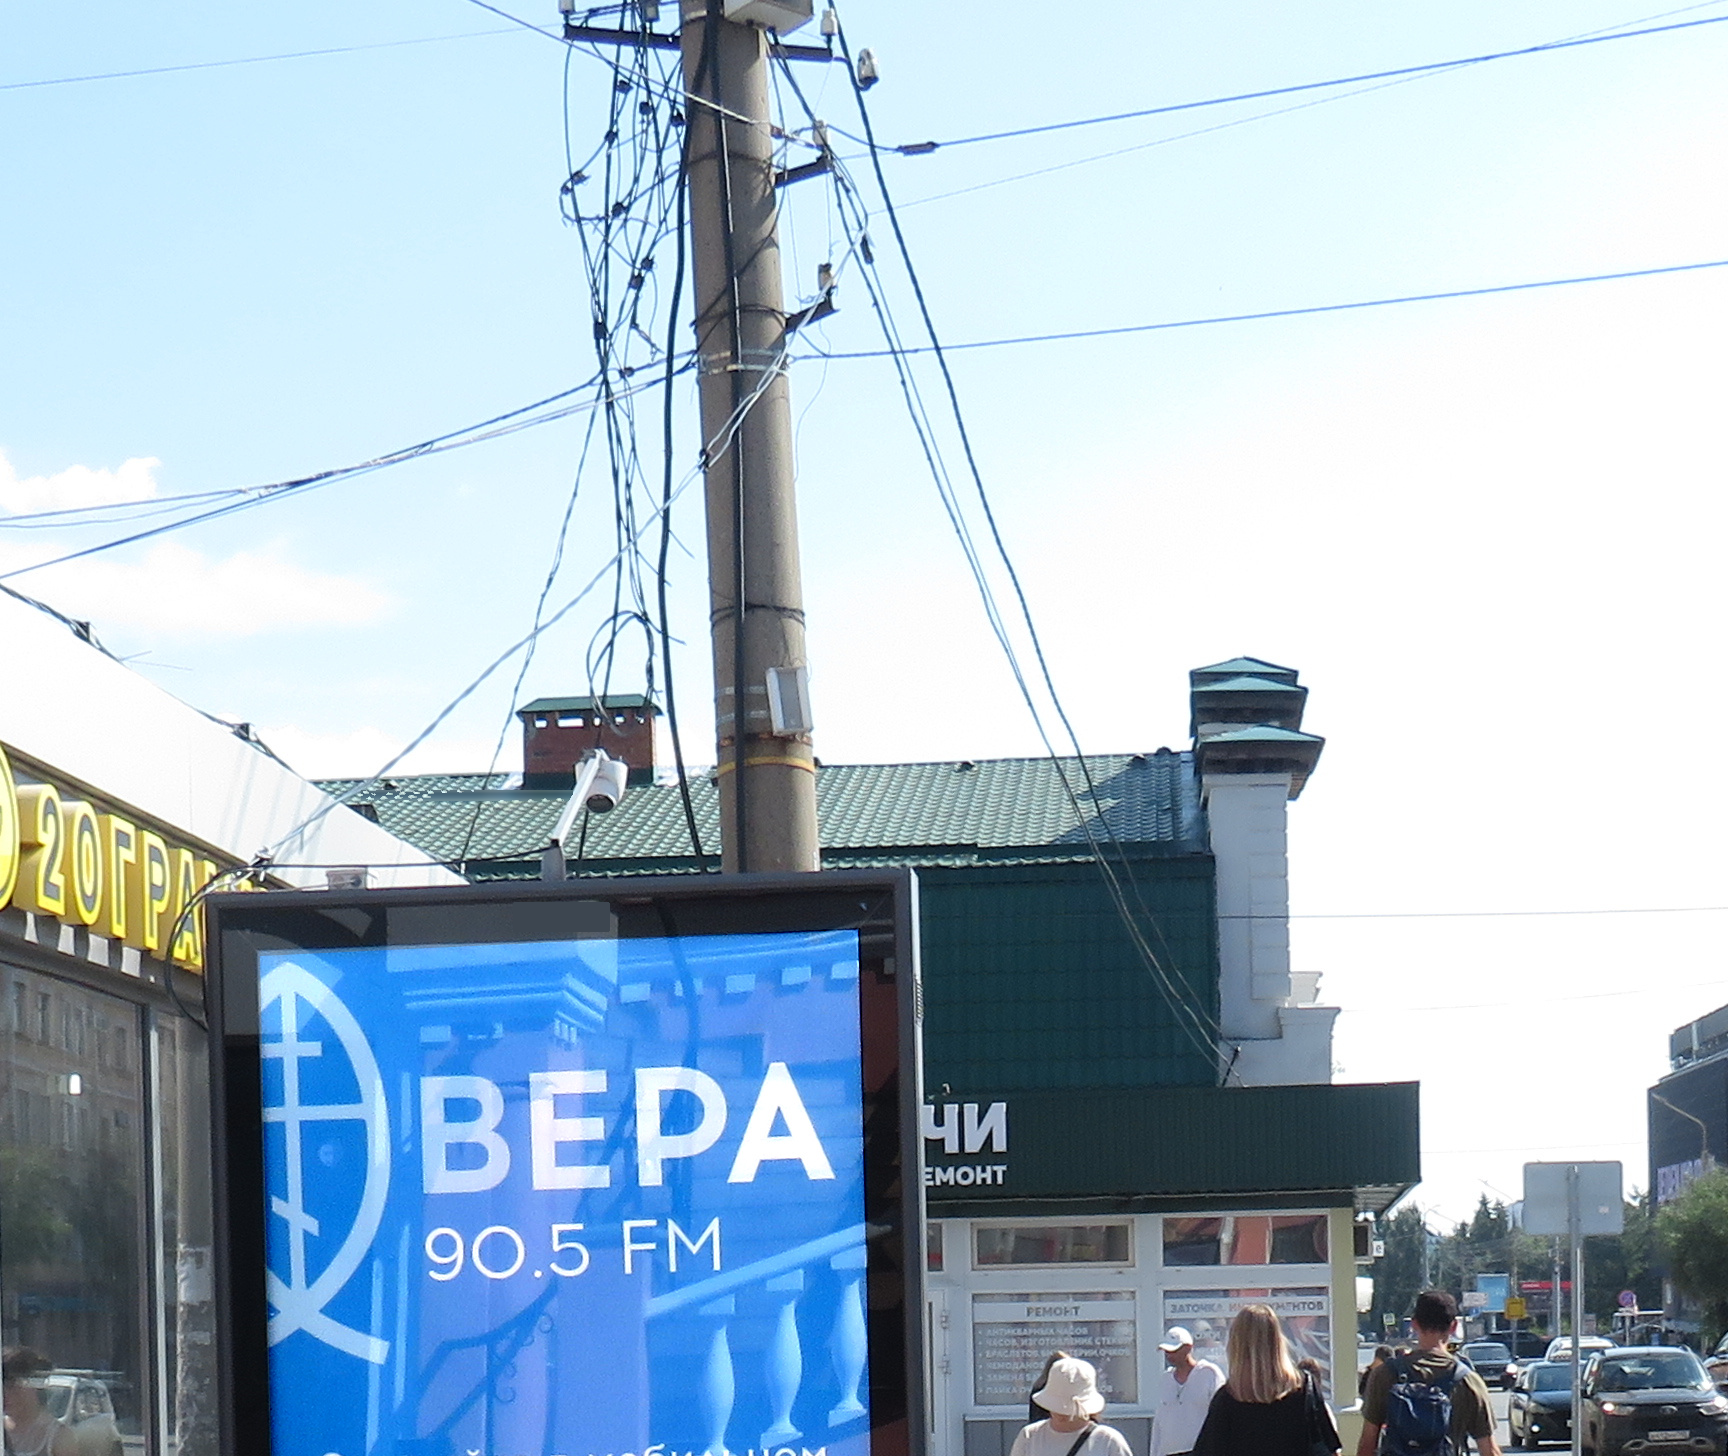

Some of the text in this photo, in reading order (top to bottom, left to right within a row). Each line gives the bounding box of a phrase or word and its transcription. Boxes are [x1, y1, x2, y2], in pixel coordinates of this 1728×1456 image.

[419, 1062, 836, 1195] ВЕРА
[923, 1102, 1007, 1154] ЧИ
[924, 1164, 1007, 1187] ЕМОНТ
[424, 1218, 722, 1282] 90.5 FM
[1026, 1305, 1081, 1317] РЕМОНТ
[1171, 1303, 1222, 1313] ЗАТОЧКА
